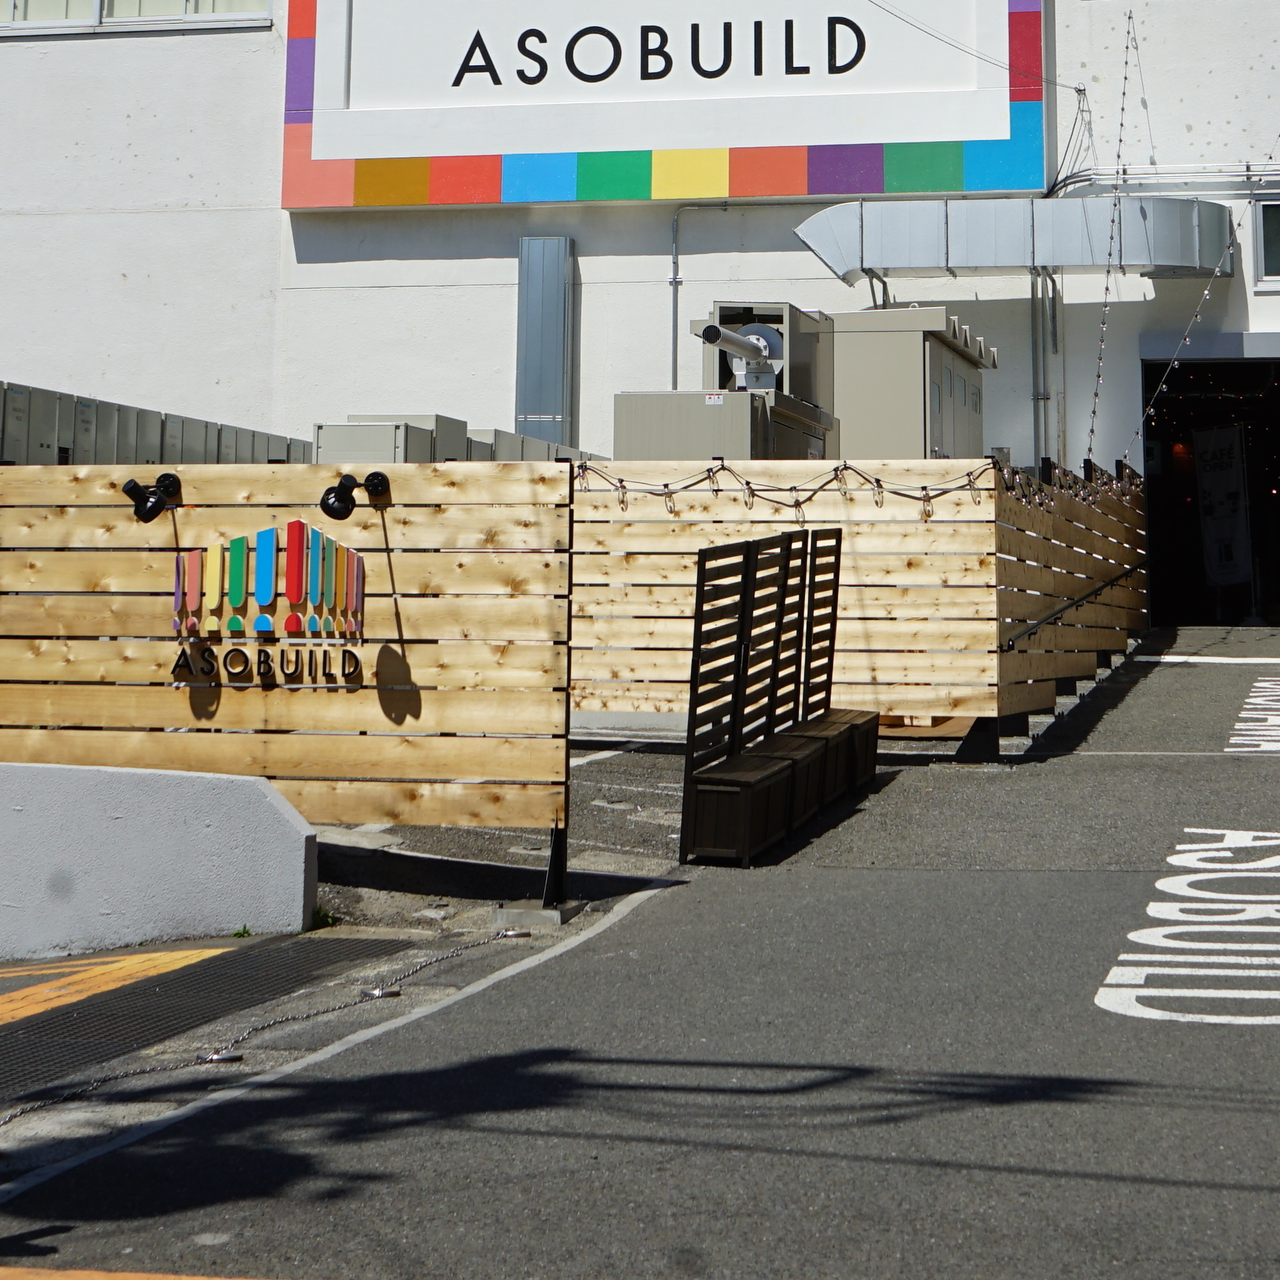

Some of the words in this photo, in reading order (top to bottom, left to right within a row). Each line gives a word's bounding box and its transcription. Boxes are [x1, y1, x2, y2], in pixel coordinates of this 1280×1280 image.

[451, 16, 866, 87] ASOBUILD
[1204, 461, 1234, 474] OPEN
[170, 646, 362, 680] ASOBUILD
